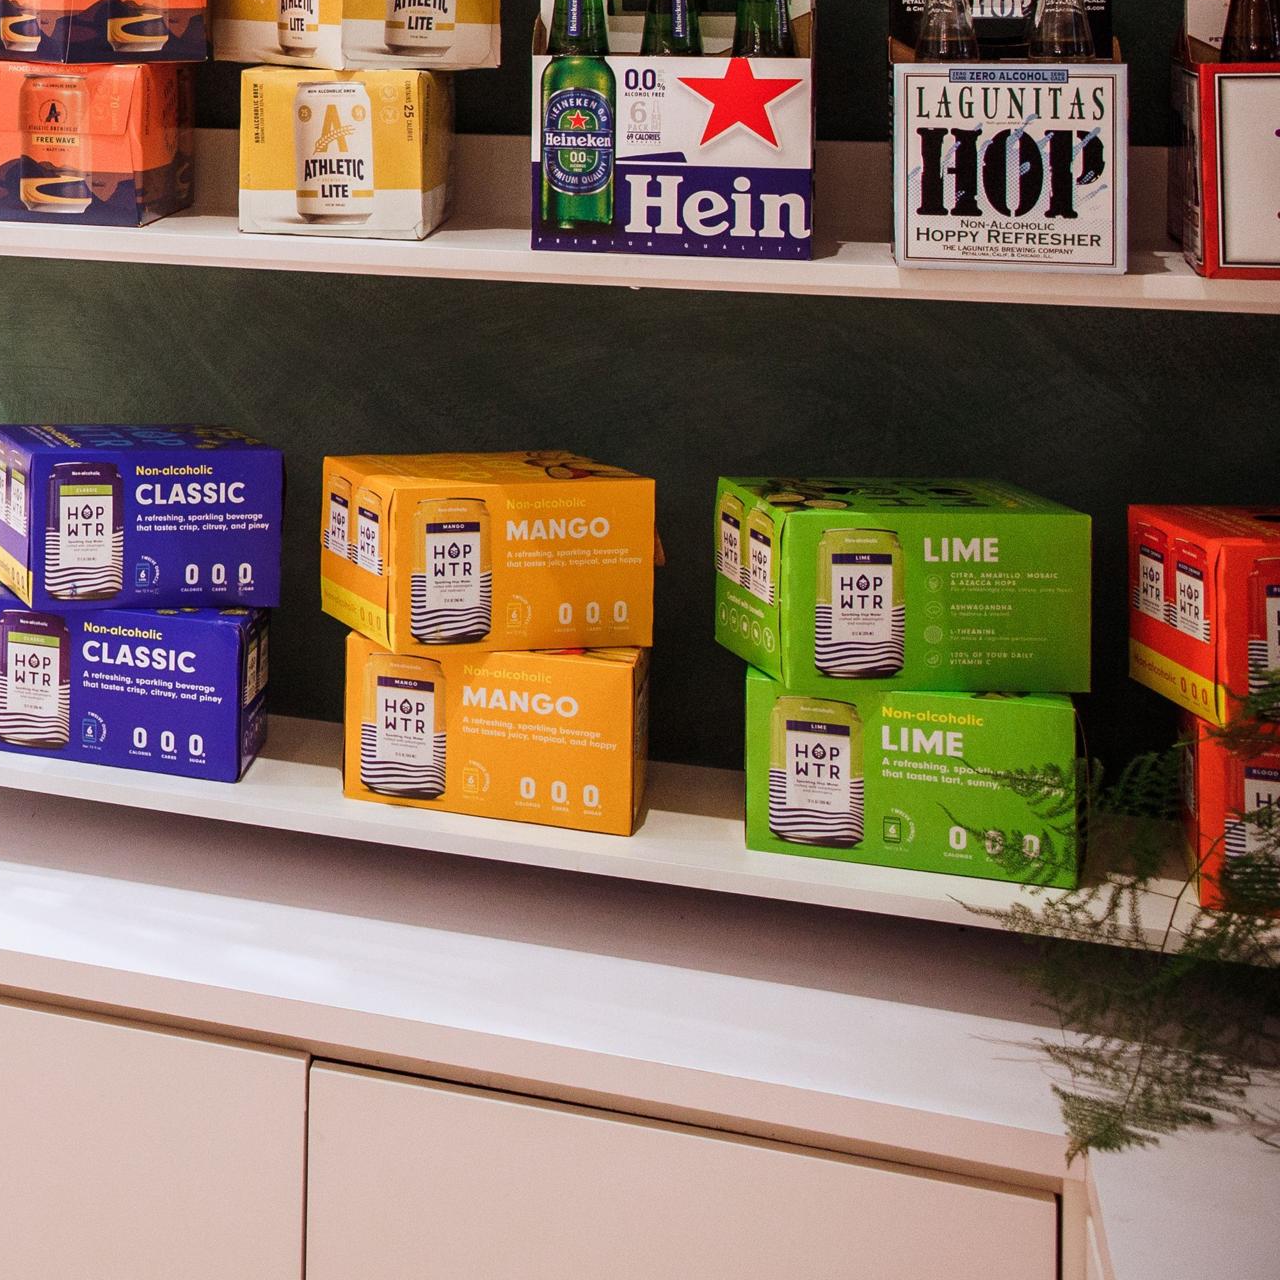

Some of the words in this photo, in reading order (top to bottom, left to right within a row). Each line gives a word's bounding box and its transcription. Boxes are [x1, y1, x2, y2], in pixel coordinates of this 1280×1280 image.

[289, 17, 305, 32] LITE
[408, 16, 433, 31] LITE
[970, 72, 996, 81] ZERO
[999, 72, 1048, 81] ALCOHOL
[630, 101, 647, 123] 6
[916, 86, 1104, 121] LAGUNITAS
[36, 136, 54, 144] FREE
[56, 136, 76, 144] WAVE
[545, 132, 611, 148] Heineken
[304, 159, 364, 182] ATHLETIC
[916, 128, 1105, 219] HOP
[321, 184, 349, 198] LITE
[625, 174, 811, 239] Hein
[136, 465, 213, 476] Non-alcoholic
[135, 482, 245, 505] CLASSIC
[506, 497, 586, 511] Non-alcoholic
[67, 523, 104, 537] WTR
[506, 517, 611, 541] MANGO
[923, 538, 999, 563] LIME
[434, 562, 472, 577] WTR
[841, 595, 883, 609] WTR
[84, 622, 163, 641] Non-alcoholic
[82, 641, 196, 673] CLASSIC
[15, 671, 51, 687] WTR
[91, 671, 133, 685] refreshing,
[136, 676, 173, 689] sparkling
[176, 681, 215, 693] beverage
[394, 679, 418, 687] MANGO
[463, 665, 552, 685] Non-alcoholic
[83, 680, 99, 689] that
[101, 683, 125, 691] tastes
[127, 686, 148, 696] crisp,
[151, 688, 178, 700] citrusy,
[180, 692, 196, 701] and
[199, 695, 222, 705] piney
[463, 686, 579, 718] MANGO
[385, 717, 425, 734] WTR
[881, 706, 984, 727] Non-alcoholic
[881, 725, 964, 758] LIME
[795, 762, 840, 780] WTR
